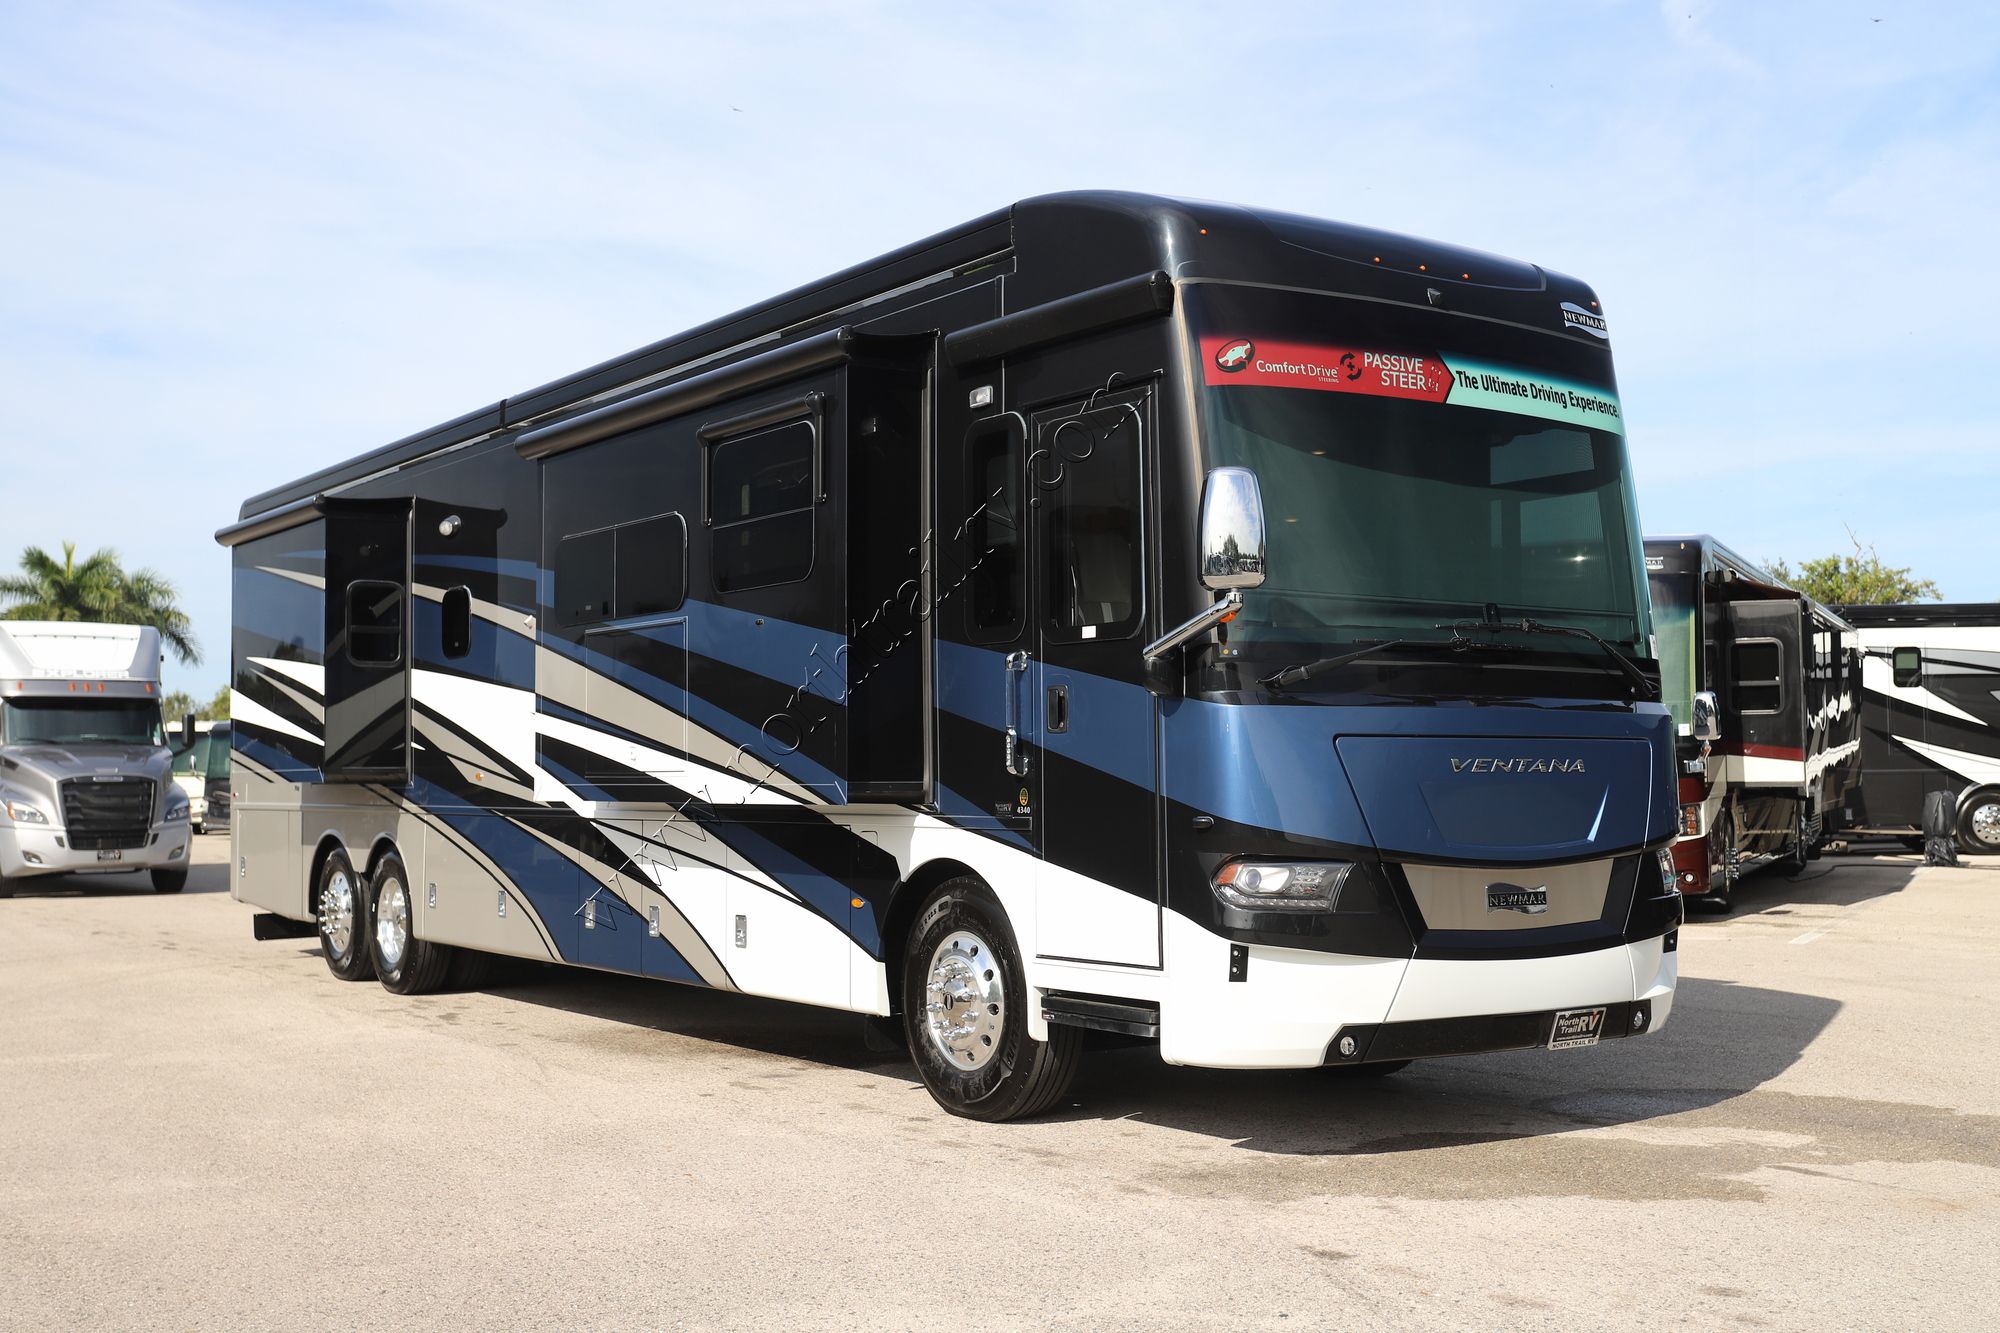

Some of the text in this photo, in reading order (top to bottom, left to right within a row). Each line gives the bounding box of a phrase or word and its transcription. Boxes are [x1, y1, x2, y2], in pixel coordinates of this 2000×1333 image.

[1256, 360, 1339, 378] Comfort Drive
[1364, 352, 1424, 374] PASSIVE
[1381, 370, 1427, 391] STEER
[1455, 370, 1479, 390] The
[1480, 374, 1529, 398] Ultimate
[1531, 383, 1567, 409] Driving
[1450, 758, 1586, 773] VENTANA
[1016, 806, 1031, 814] 4340
[1489, 893, 1547, 906] NEWMAR
[1558, 1017, 1580, 1027] North
[1561, 1026, 1578, 1034] Trail
[1577, 1014, 1601, 1032] RV
